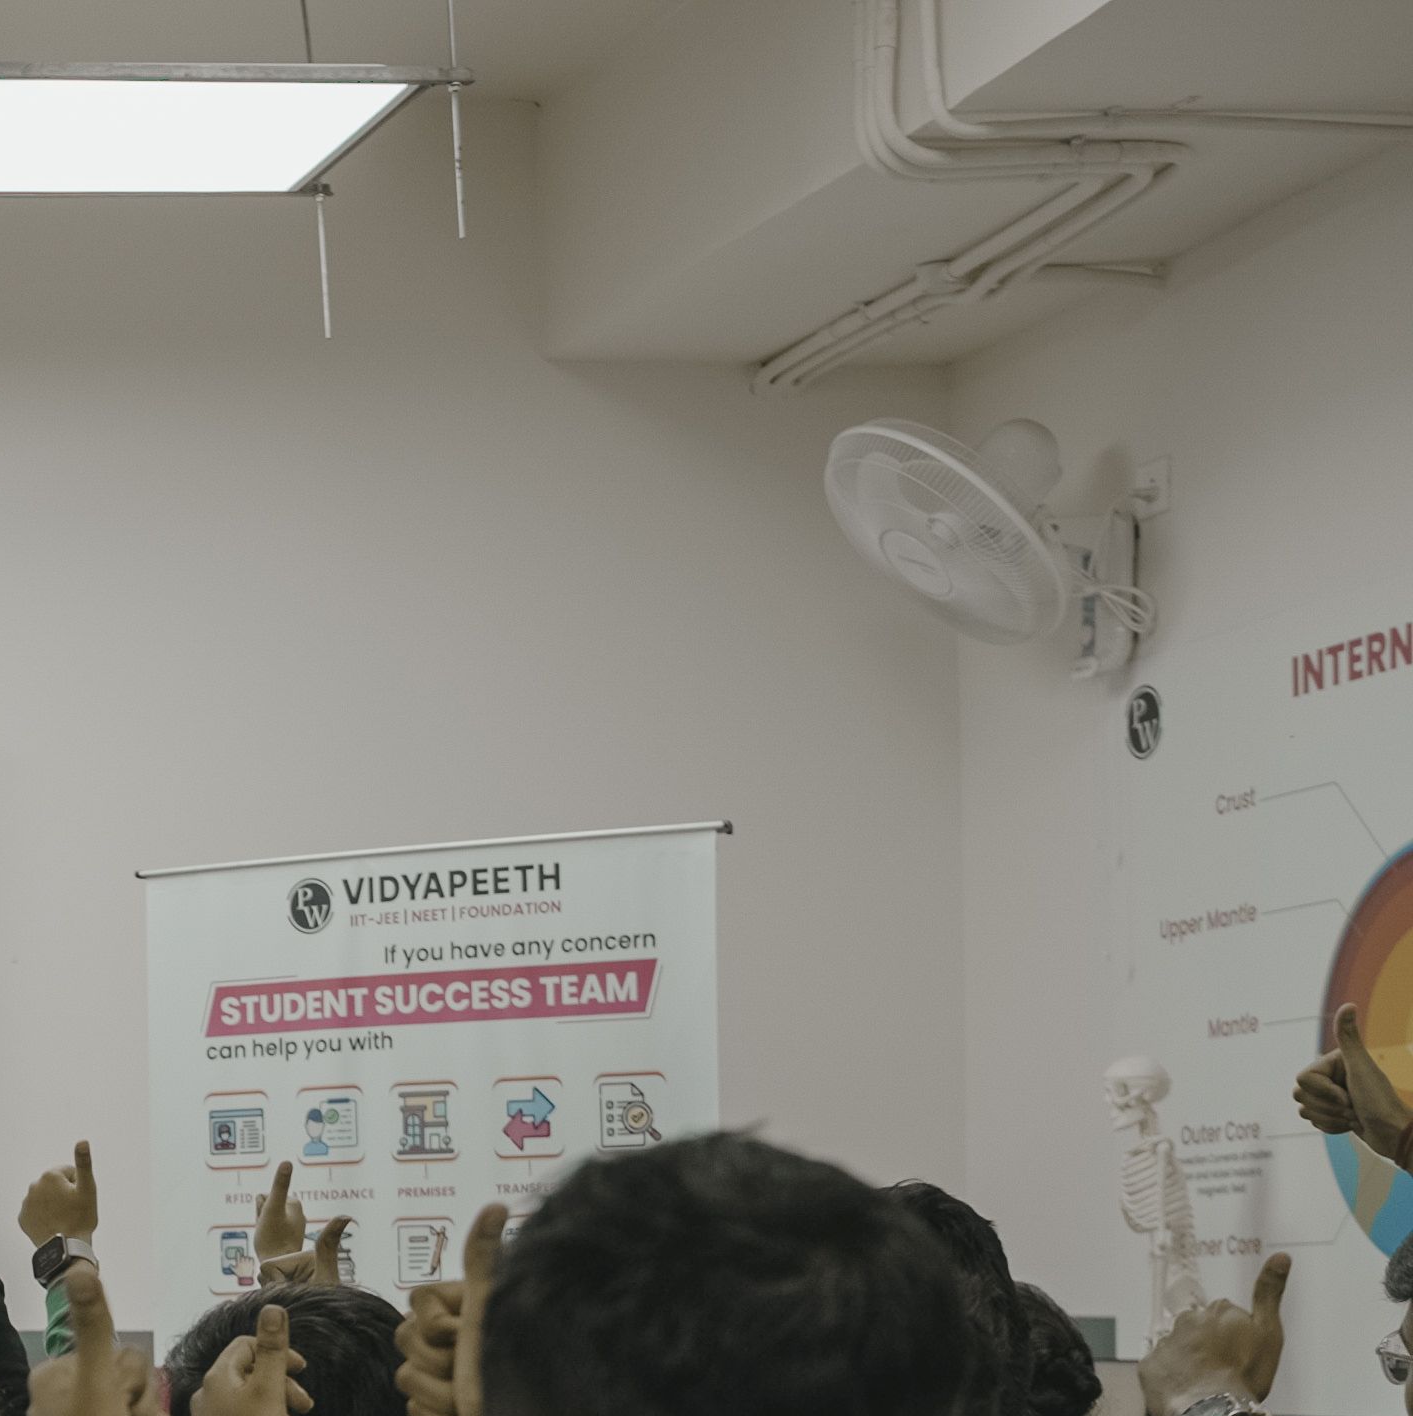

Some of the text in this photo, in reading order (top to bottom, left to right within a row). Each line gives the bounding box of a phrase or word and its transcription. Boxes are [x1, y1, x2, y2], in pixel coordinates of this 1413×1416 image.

[1291, 622, 1413, 697] INTERN
[1215, 786, 1257, 816] Crust
[342, 863, 561, 906] VIDYAPEETH
[349, 900, 562, 928] IIT-JEE NEET FOUNDATION
[1159, 902, 1257, 945] Upper Mantle
[384, 932, 657, 969] If you have any concern
[219, 971, 640, 1025] STUDENT SUCCESS TEAM
[1207, 1013, 1260, 1039] Mantle
[206, 1030, 394, 1063] can help you with
[1181, 1120, 1261, 1145] Outer Core
[396, 1186, 456, 1199] PREMISES
[1226, 1234, 1263, 1256] Core
